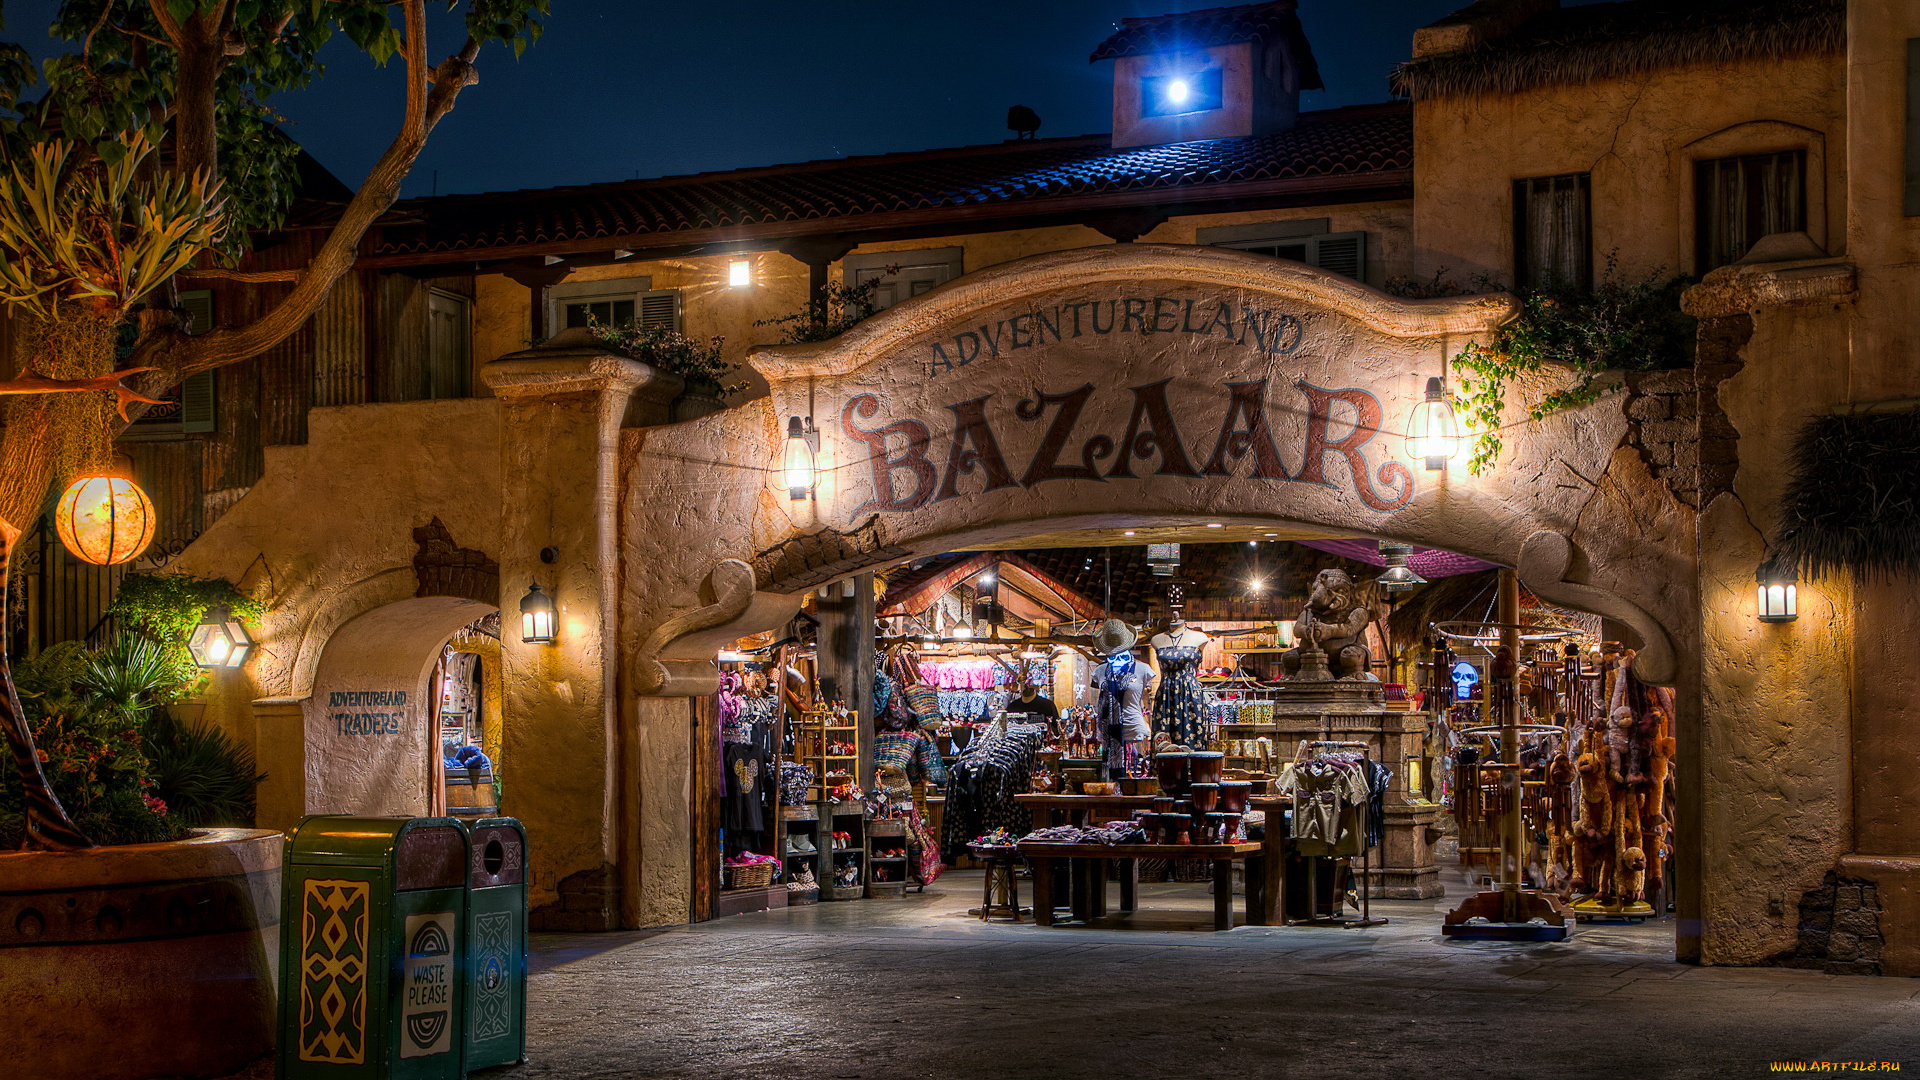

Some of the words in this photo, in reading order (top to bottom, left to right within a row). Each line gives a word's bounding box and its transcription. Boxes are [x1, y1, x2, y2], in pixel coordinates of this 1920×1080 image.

[928, 298, 1303, 377] ADVENTURELAND
[841, 378, 1414, 523] BAZAAR
[329, 691, 406, 707] ADVENTURELAND
[413, 964, 445, 985] WASTE
[409, 985, 447, 1008] PLEASE
